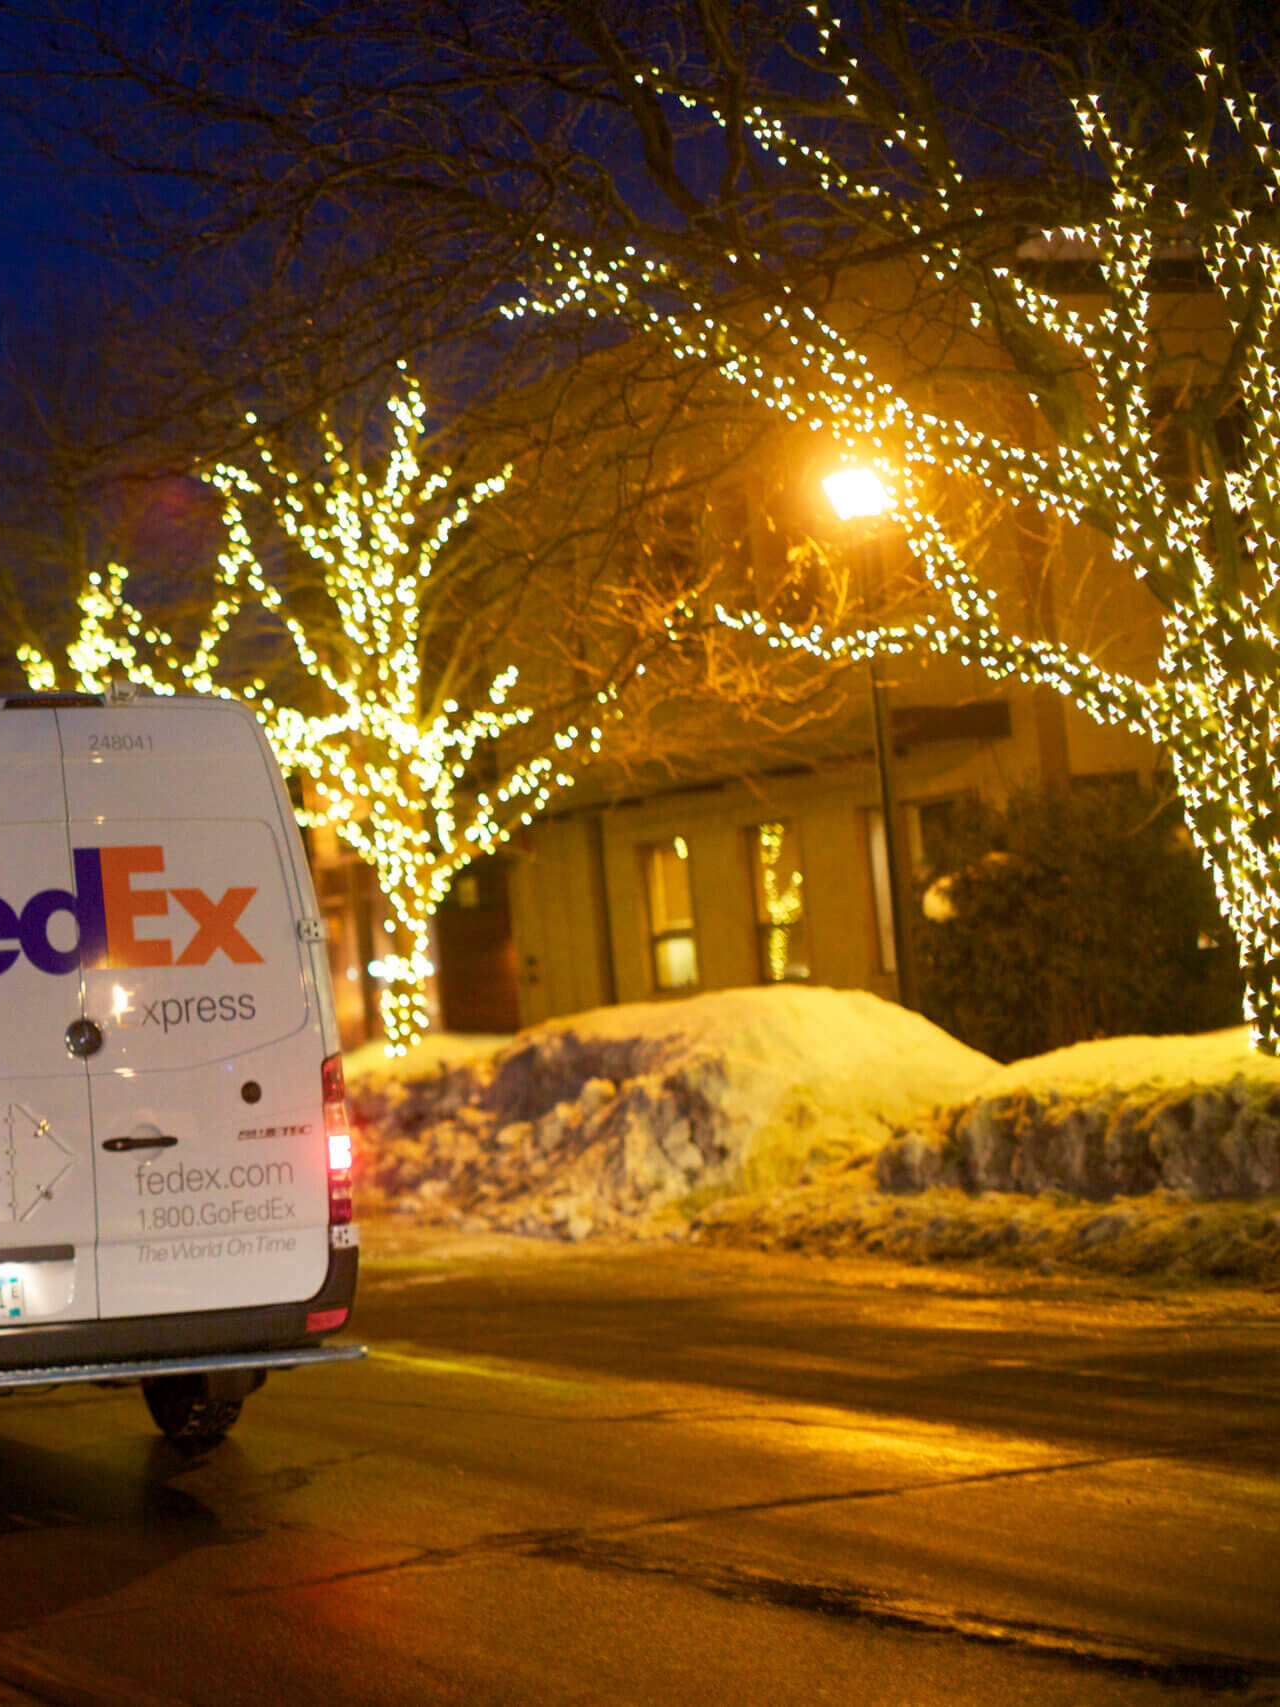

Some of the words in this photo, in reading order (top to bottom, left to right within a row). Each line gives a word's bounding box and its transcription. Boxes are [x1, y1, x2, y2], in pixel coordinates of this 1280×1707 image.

[87, 733, 153, 751] 248041
[136, 1161, 294, 1196] fedex.com
[138, 1198, 296, 1232] 1.800.GoFedEx
[136, 1244, 168, 1263] The
[171, 1239, 223, 1260] World
[227, 1237, 253, 1257] On
[256, 1235, 296, 1254] Time
